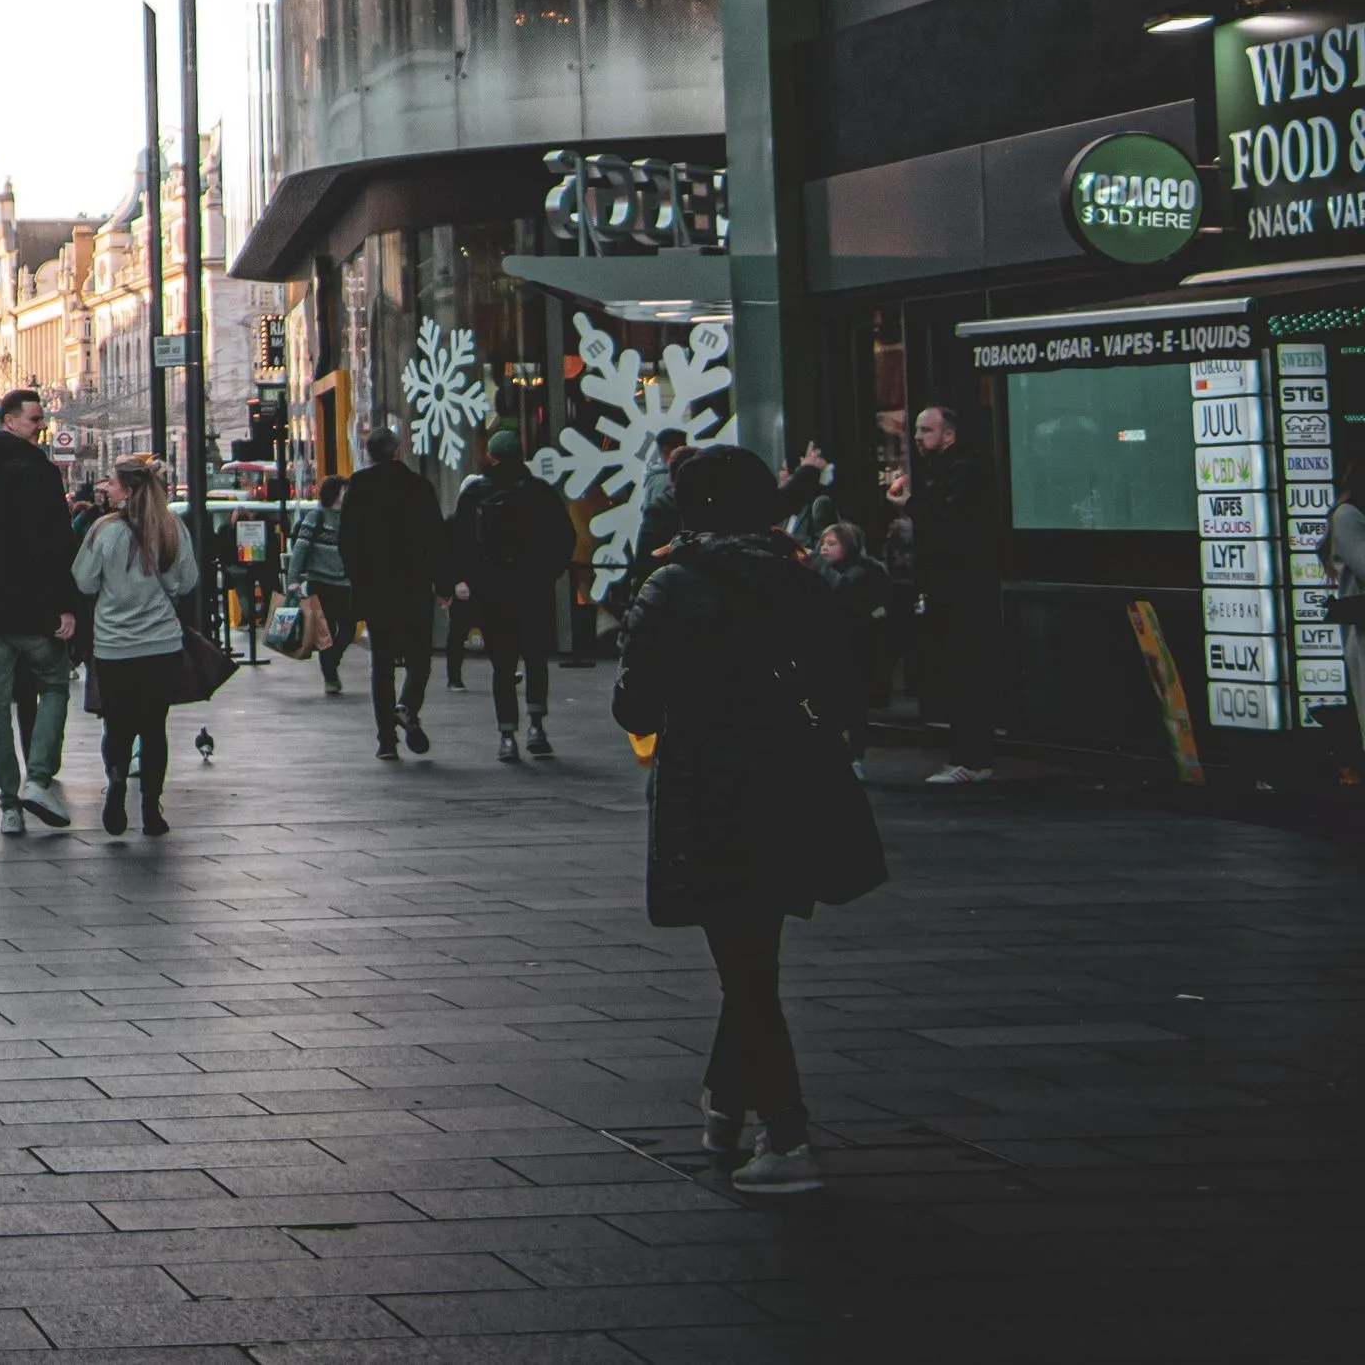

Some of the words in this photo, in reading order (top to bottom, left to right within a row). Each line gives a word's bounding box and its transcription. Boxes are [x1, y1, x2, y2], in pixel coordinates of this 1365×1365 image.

[1229, 116, 1338, 190] FOOD
[1078, 172, 1196, 210] TOBACCO
[1082, 206, 1134, 225] SOLD
[1138, 210, 1192, 229] HERE
[1248, 199, 1314, 240] SNACK
[973, 343, 1037, 367] TOBACCO
[1046, 336, 1092, 362] CIGAR
[1102, 332, 1154, 357] VAPES
[1281, 351, 1324, 368] SWEETS
[1283, 386, 1324, 403] STIG
[1212, 457, 1236, 484] CBD
[1287, 456, 1329, 471] DRINKS
[1209, 496, 1243, 517] VAPES
[1211, 544, 1246, 569] LYFT
[1296, 609, 1319, 618] GEEK
[1302, 629, 1334, 643] LYFT
[1210, 644, 1260, 672] ELUX
